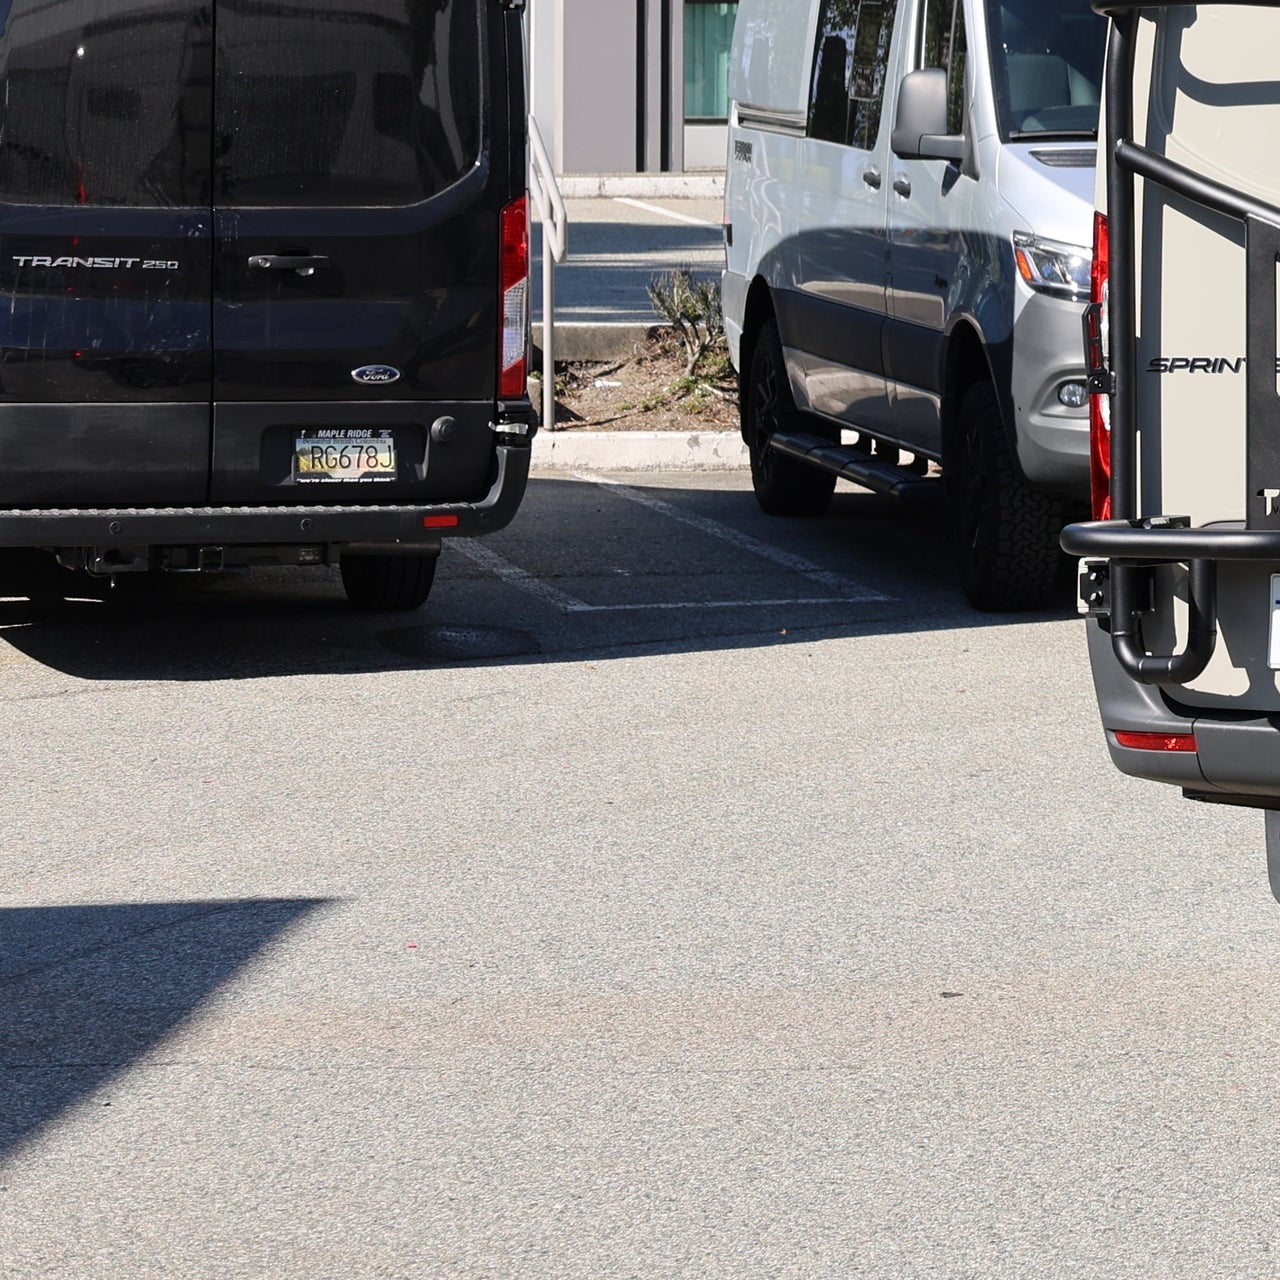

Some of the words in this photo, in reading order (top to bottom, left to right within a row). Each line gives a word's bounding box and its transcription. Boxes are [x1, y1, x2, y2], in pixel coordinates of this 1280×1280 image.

[12, 256, 140, 268] TRANSIT
[142, 260, 179, 269] 250
[317, 429, 346, 438] MAPLE
[347, 429, 373, 438] RIDGE
[311, 445, 392, 470] RG678J
